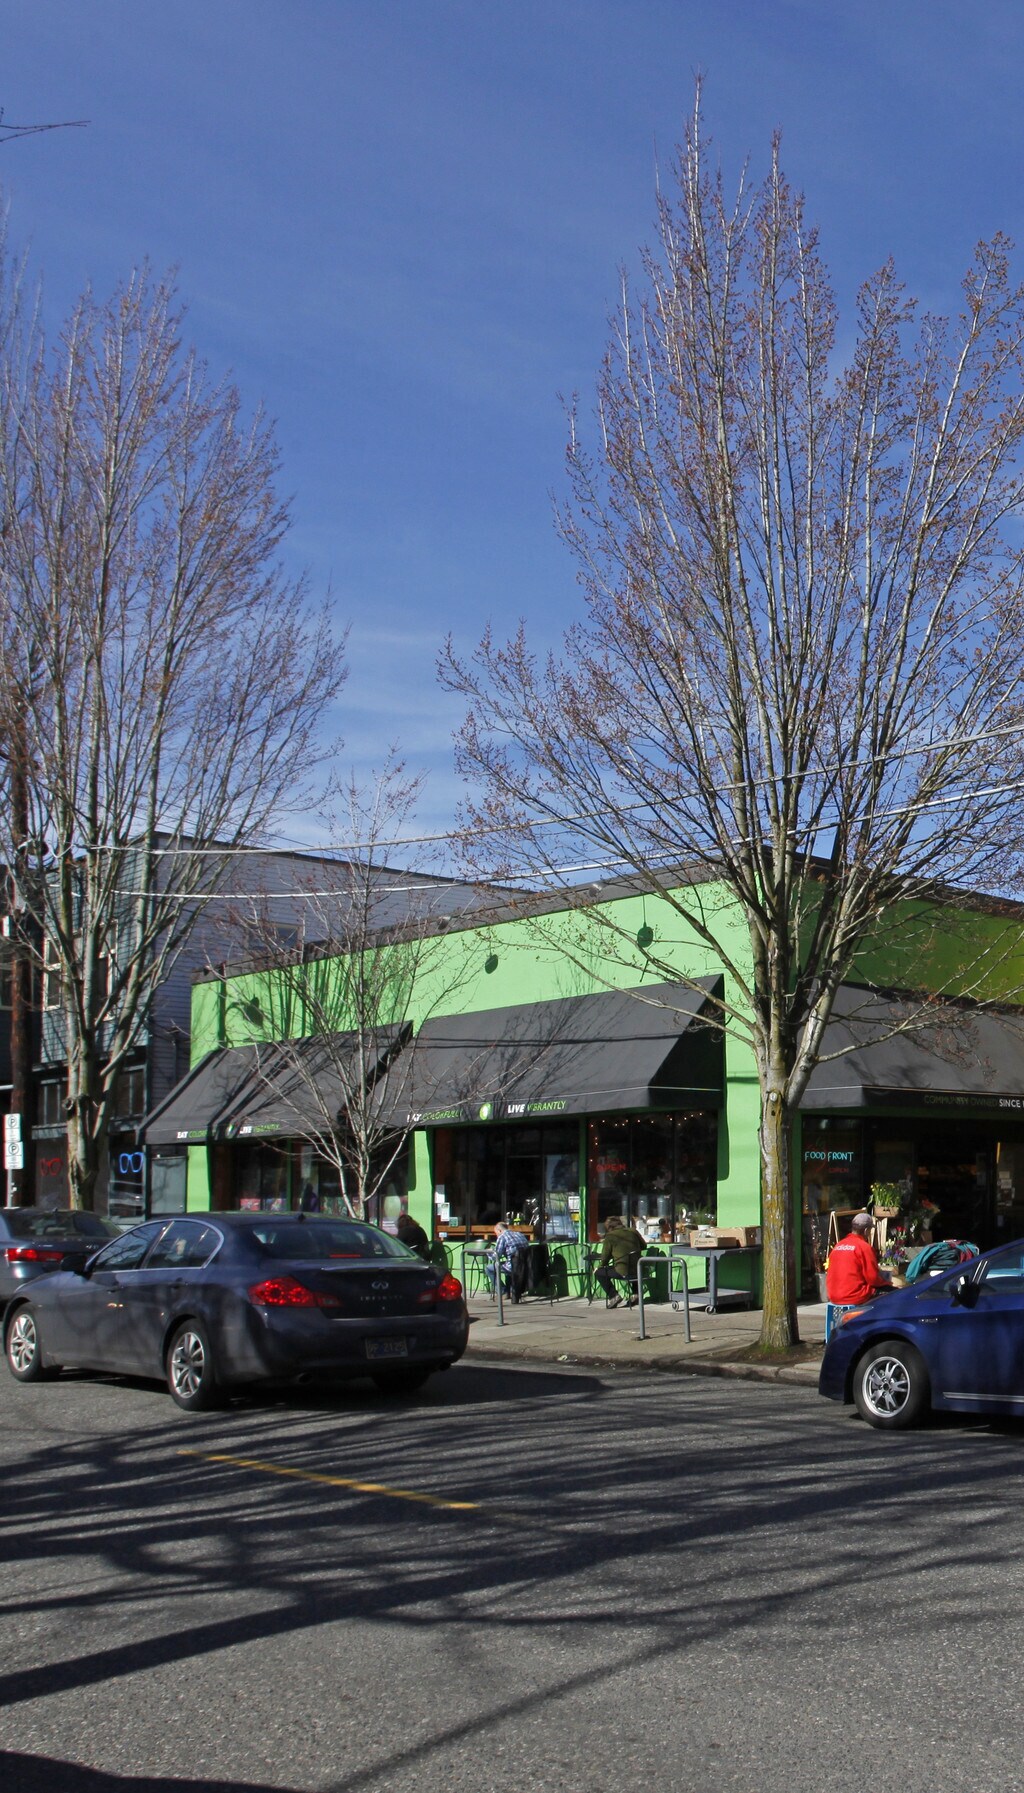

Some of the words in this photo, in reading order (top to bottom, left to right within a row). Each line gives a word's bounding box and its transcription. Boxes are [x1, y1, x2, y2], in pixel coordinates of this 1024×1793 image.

[507, 1103, 525, 1114] LIVE
[1000, 1098, 1021, 1108] SINCE
[804, 1151, 826, 1162] FOOD
[828, 1151, 854, 1162] FRONT
